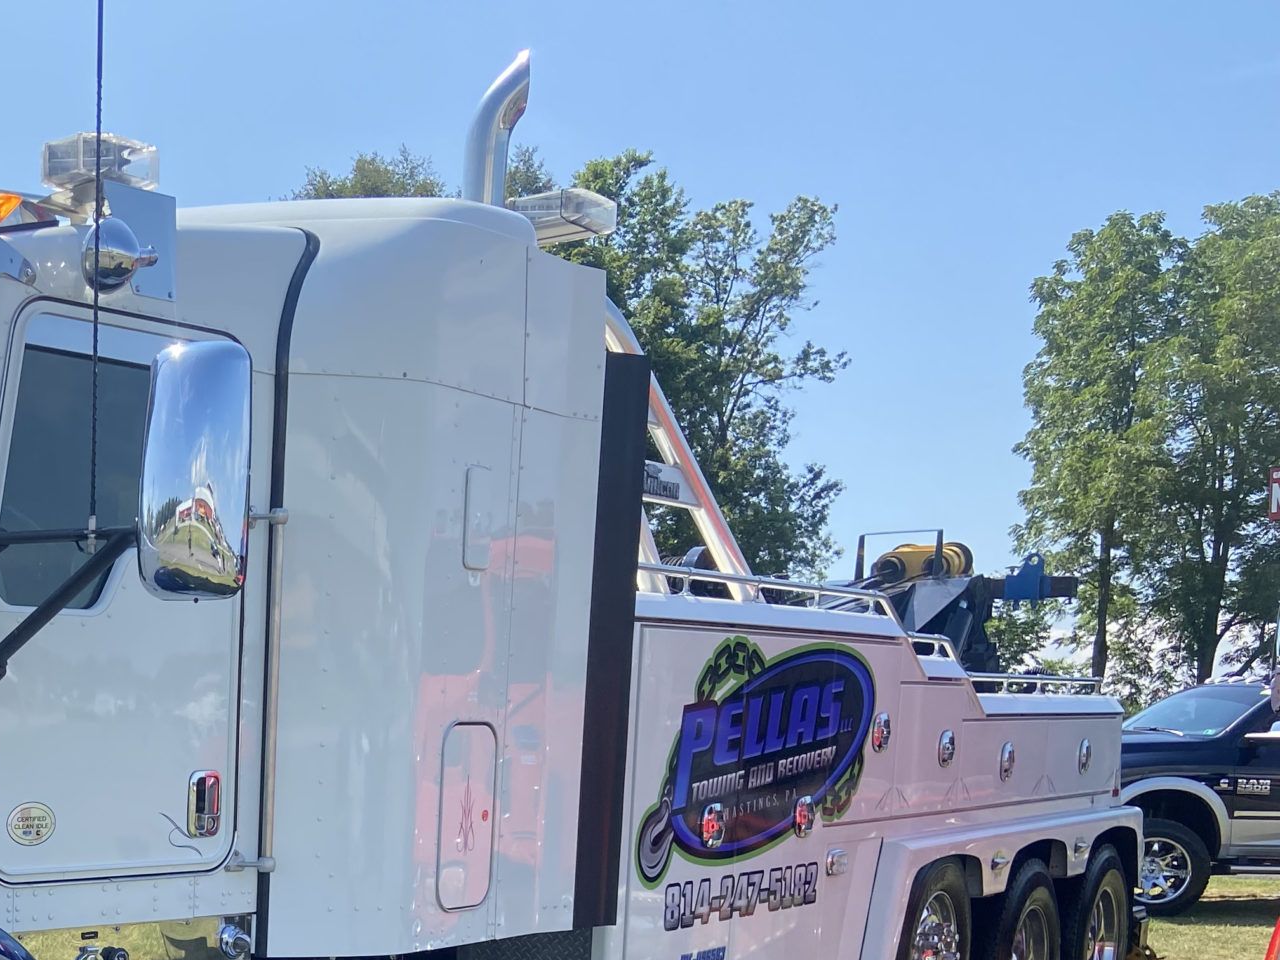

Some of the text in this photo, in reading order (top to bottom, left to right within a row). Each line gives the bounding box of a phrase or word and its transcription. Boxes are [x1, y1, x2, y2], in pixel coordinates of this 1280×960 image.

[672, 679, 846, 811] PELLAS
[692, 745, 837, 803] TOWING AND RECOVERY
[664, 861, 819, 932] 814-247-5182
